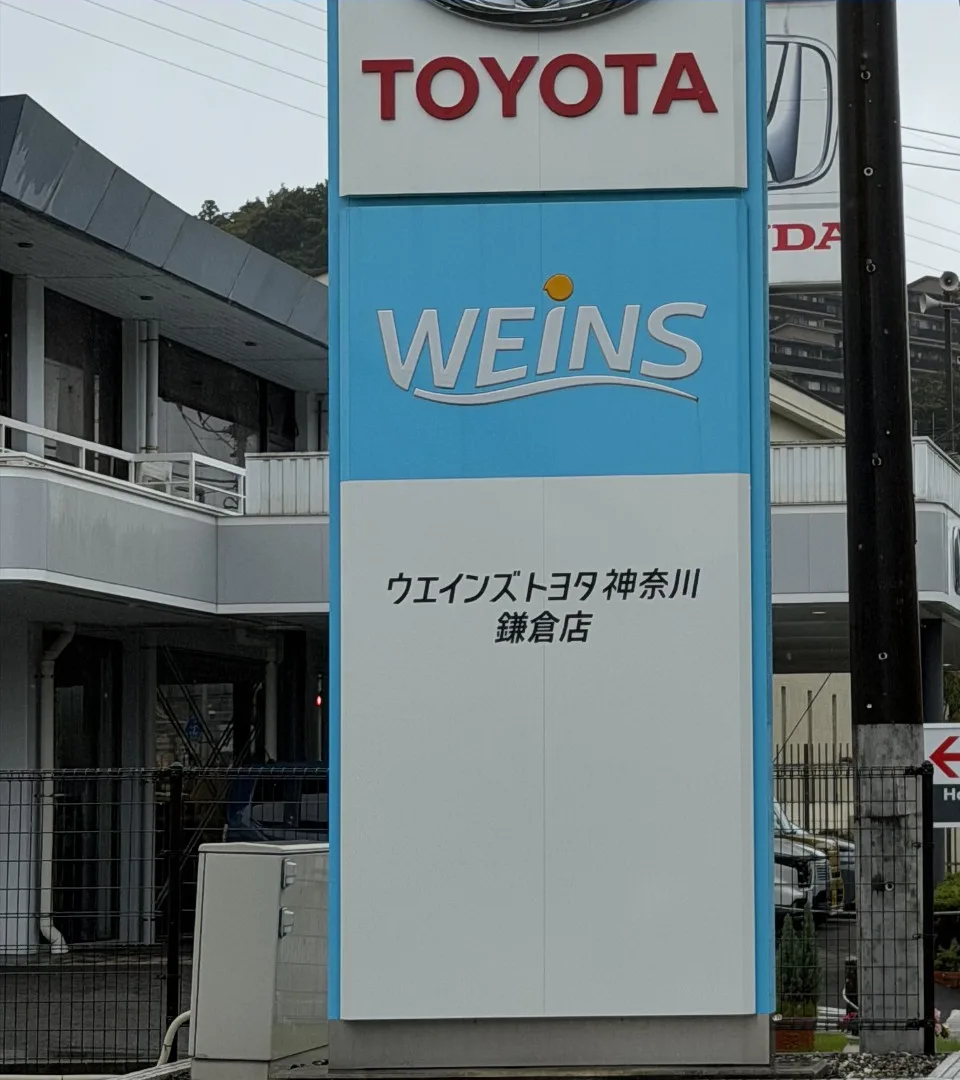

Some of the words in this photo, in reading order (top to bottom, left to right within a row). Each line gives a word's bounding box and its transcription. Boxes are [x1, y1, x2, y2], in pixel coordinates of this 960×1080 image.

[361, 51, 719, 121] TOYOTA
[387, 567, 701, 605] ウエインズトヨタ神奈川
[494, 609, 593, 644] 鎌倉店
